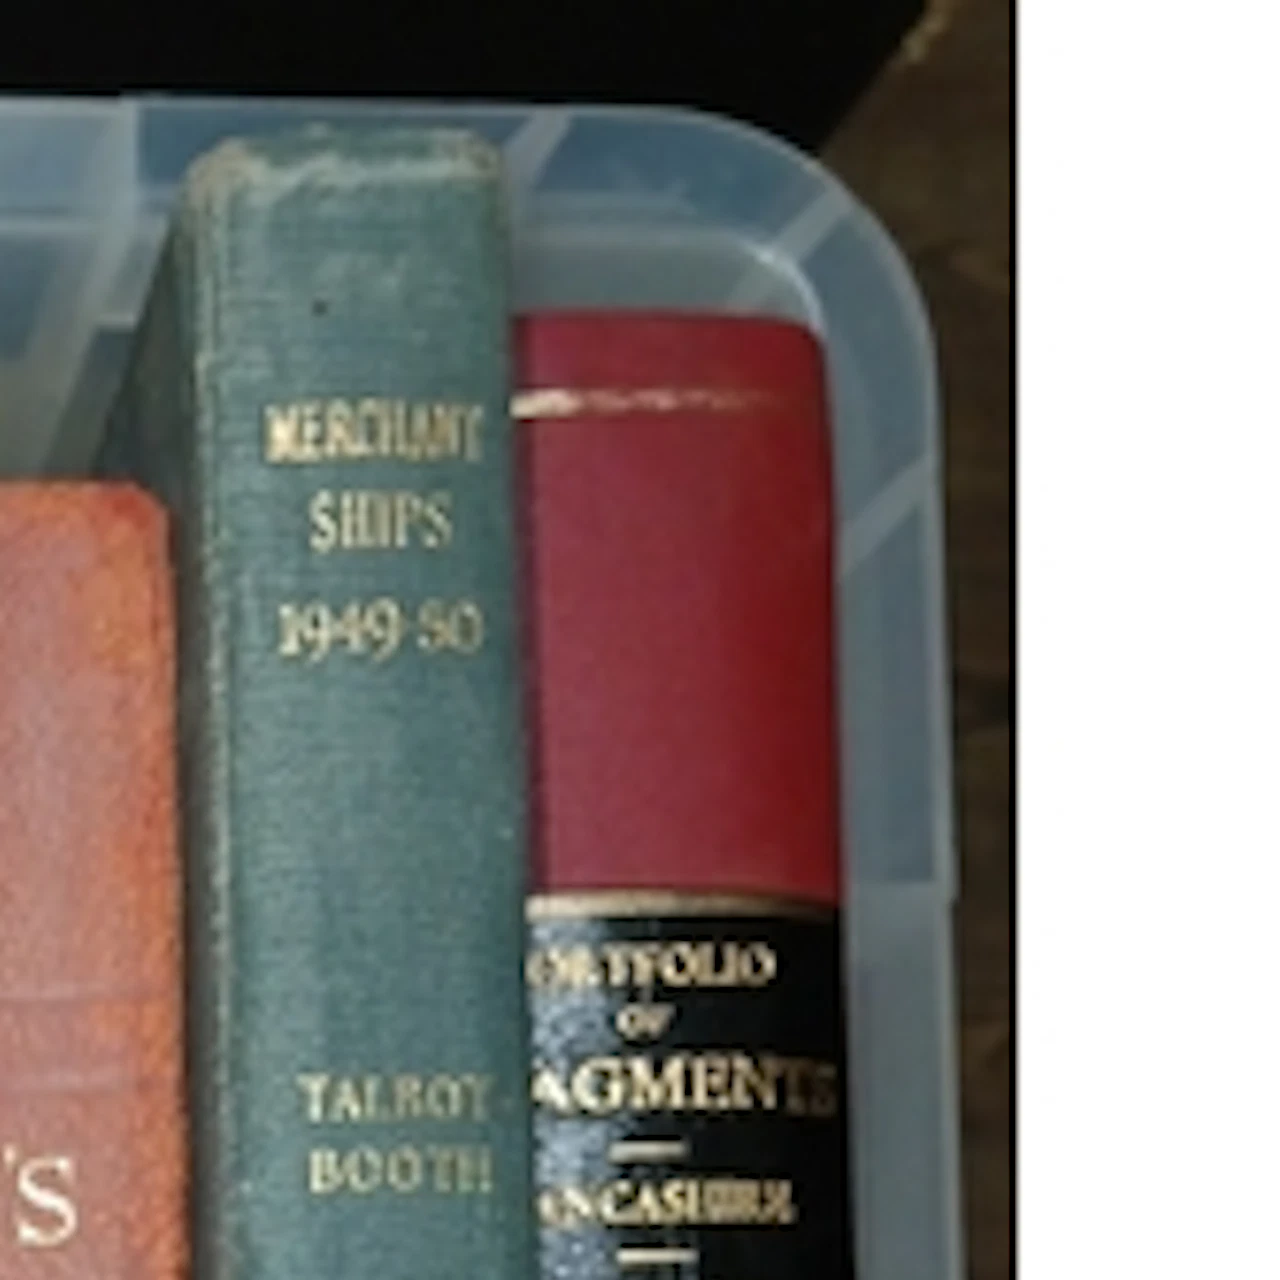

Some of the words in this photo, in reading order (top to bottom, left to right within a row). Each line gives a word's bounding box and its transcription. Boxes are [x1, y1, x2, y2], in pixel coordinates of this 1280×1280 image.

[264, 398, 486, 465] MERCHANT
[307, 489, 454, 553] SHIPS
[527, 940, 778, 990] ORTFOLIO
[296, 1069, 494, 1123] TALBOT
[532, 1052, 838, 1116] AGMENTS
[307, 1144, 494, 1195] BOOTH
[538, 1178, 797, 1226] ANCASHIRE
